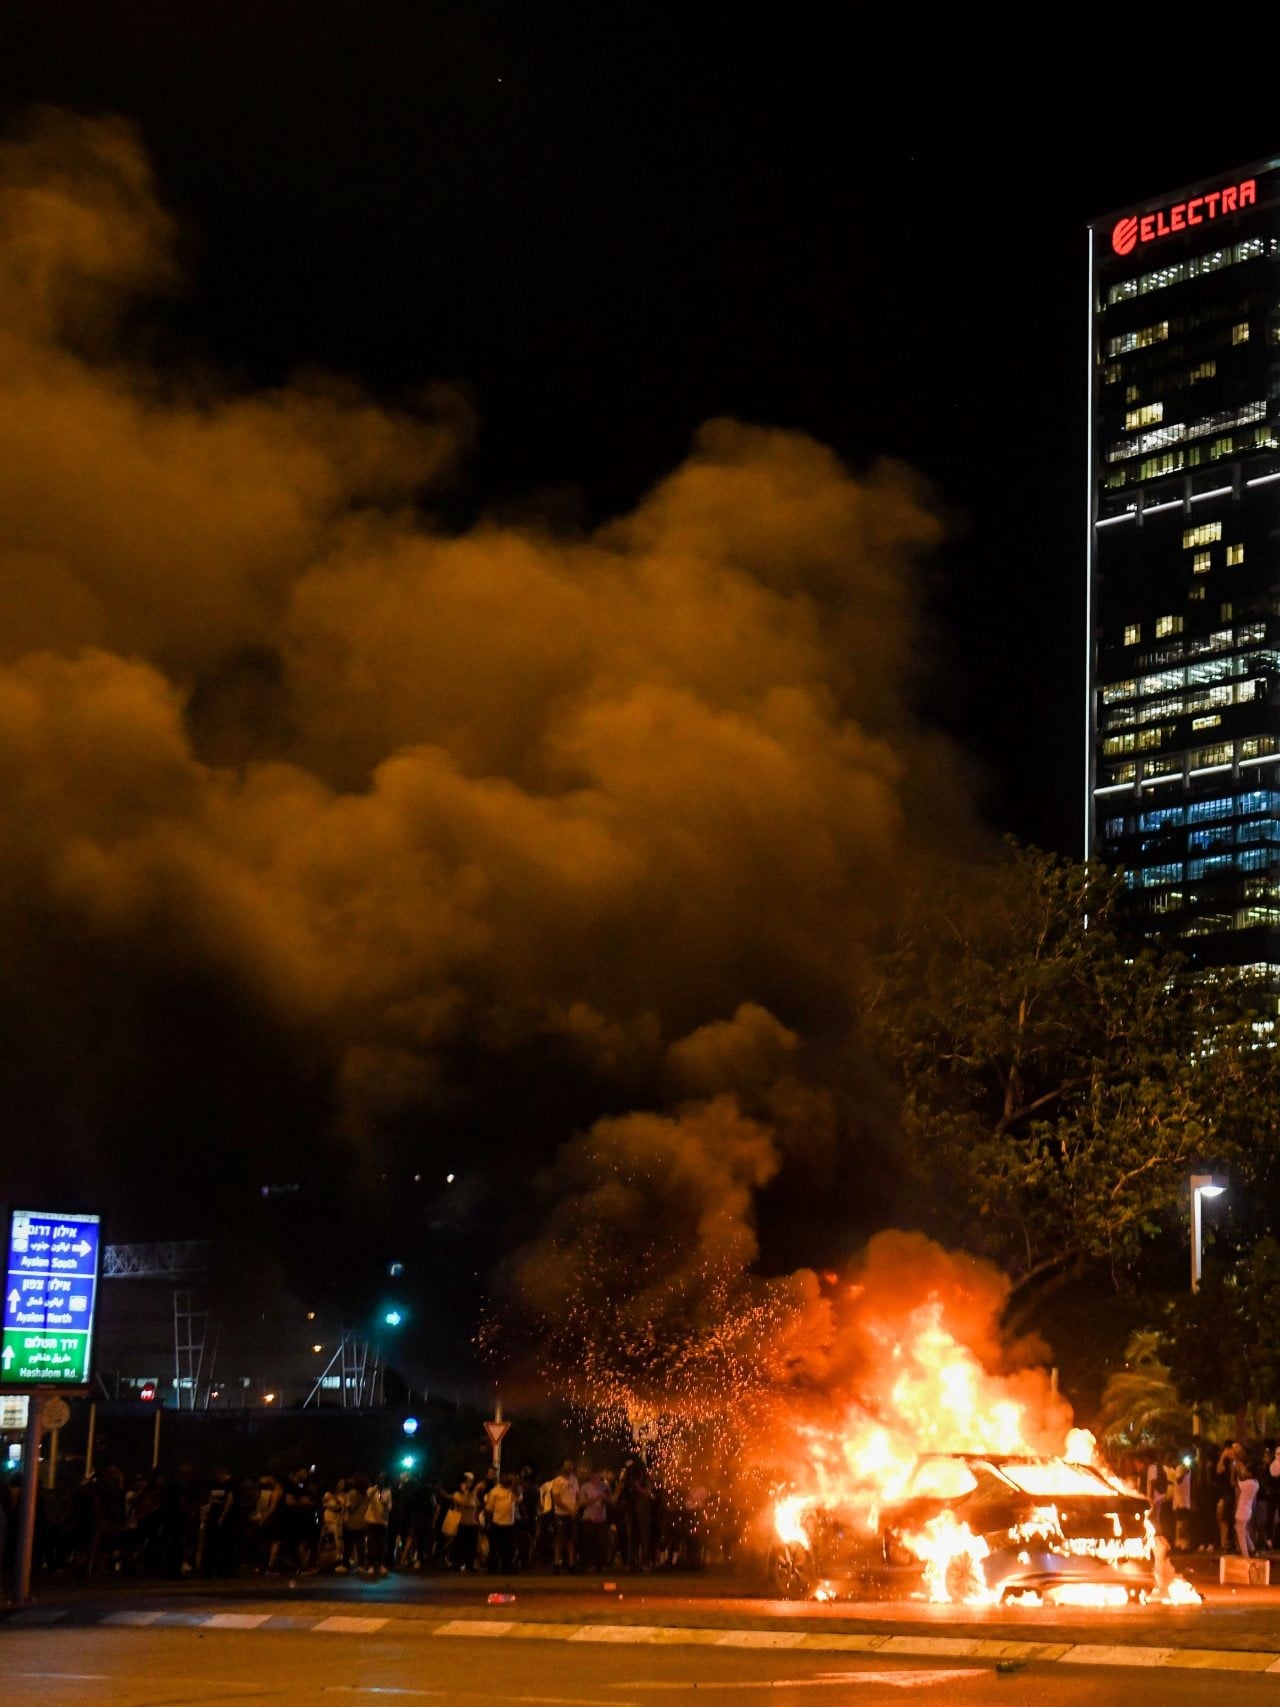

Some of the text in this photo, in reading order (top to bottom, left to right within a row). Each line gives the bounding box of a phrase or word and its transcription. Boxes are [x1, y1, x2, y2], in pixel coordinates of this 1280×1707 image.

[1140, 179, 1256, 242] ELECTRA
[53, 1225, 77, 1239] אילון
[21, 1256, 77, 1269] Ayalon South
[22, 1279, 44, 1291] צפון
[16, 1312, 72, 1324] Ayalon North
[24, 1336, 78, 1351] דרך השלום
[20, 1367, 78, 1378] Hashalom Rd.
